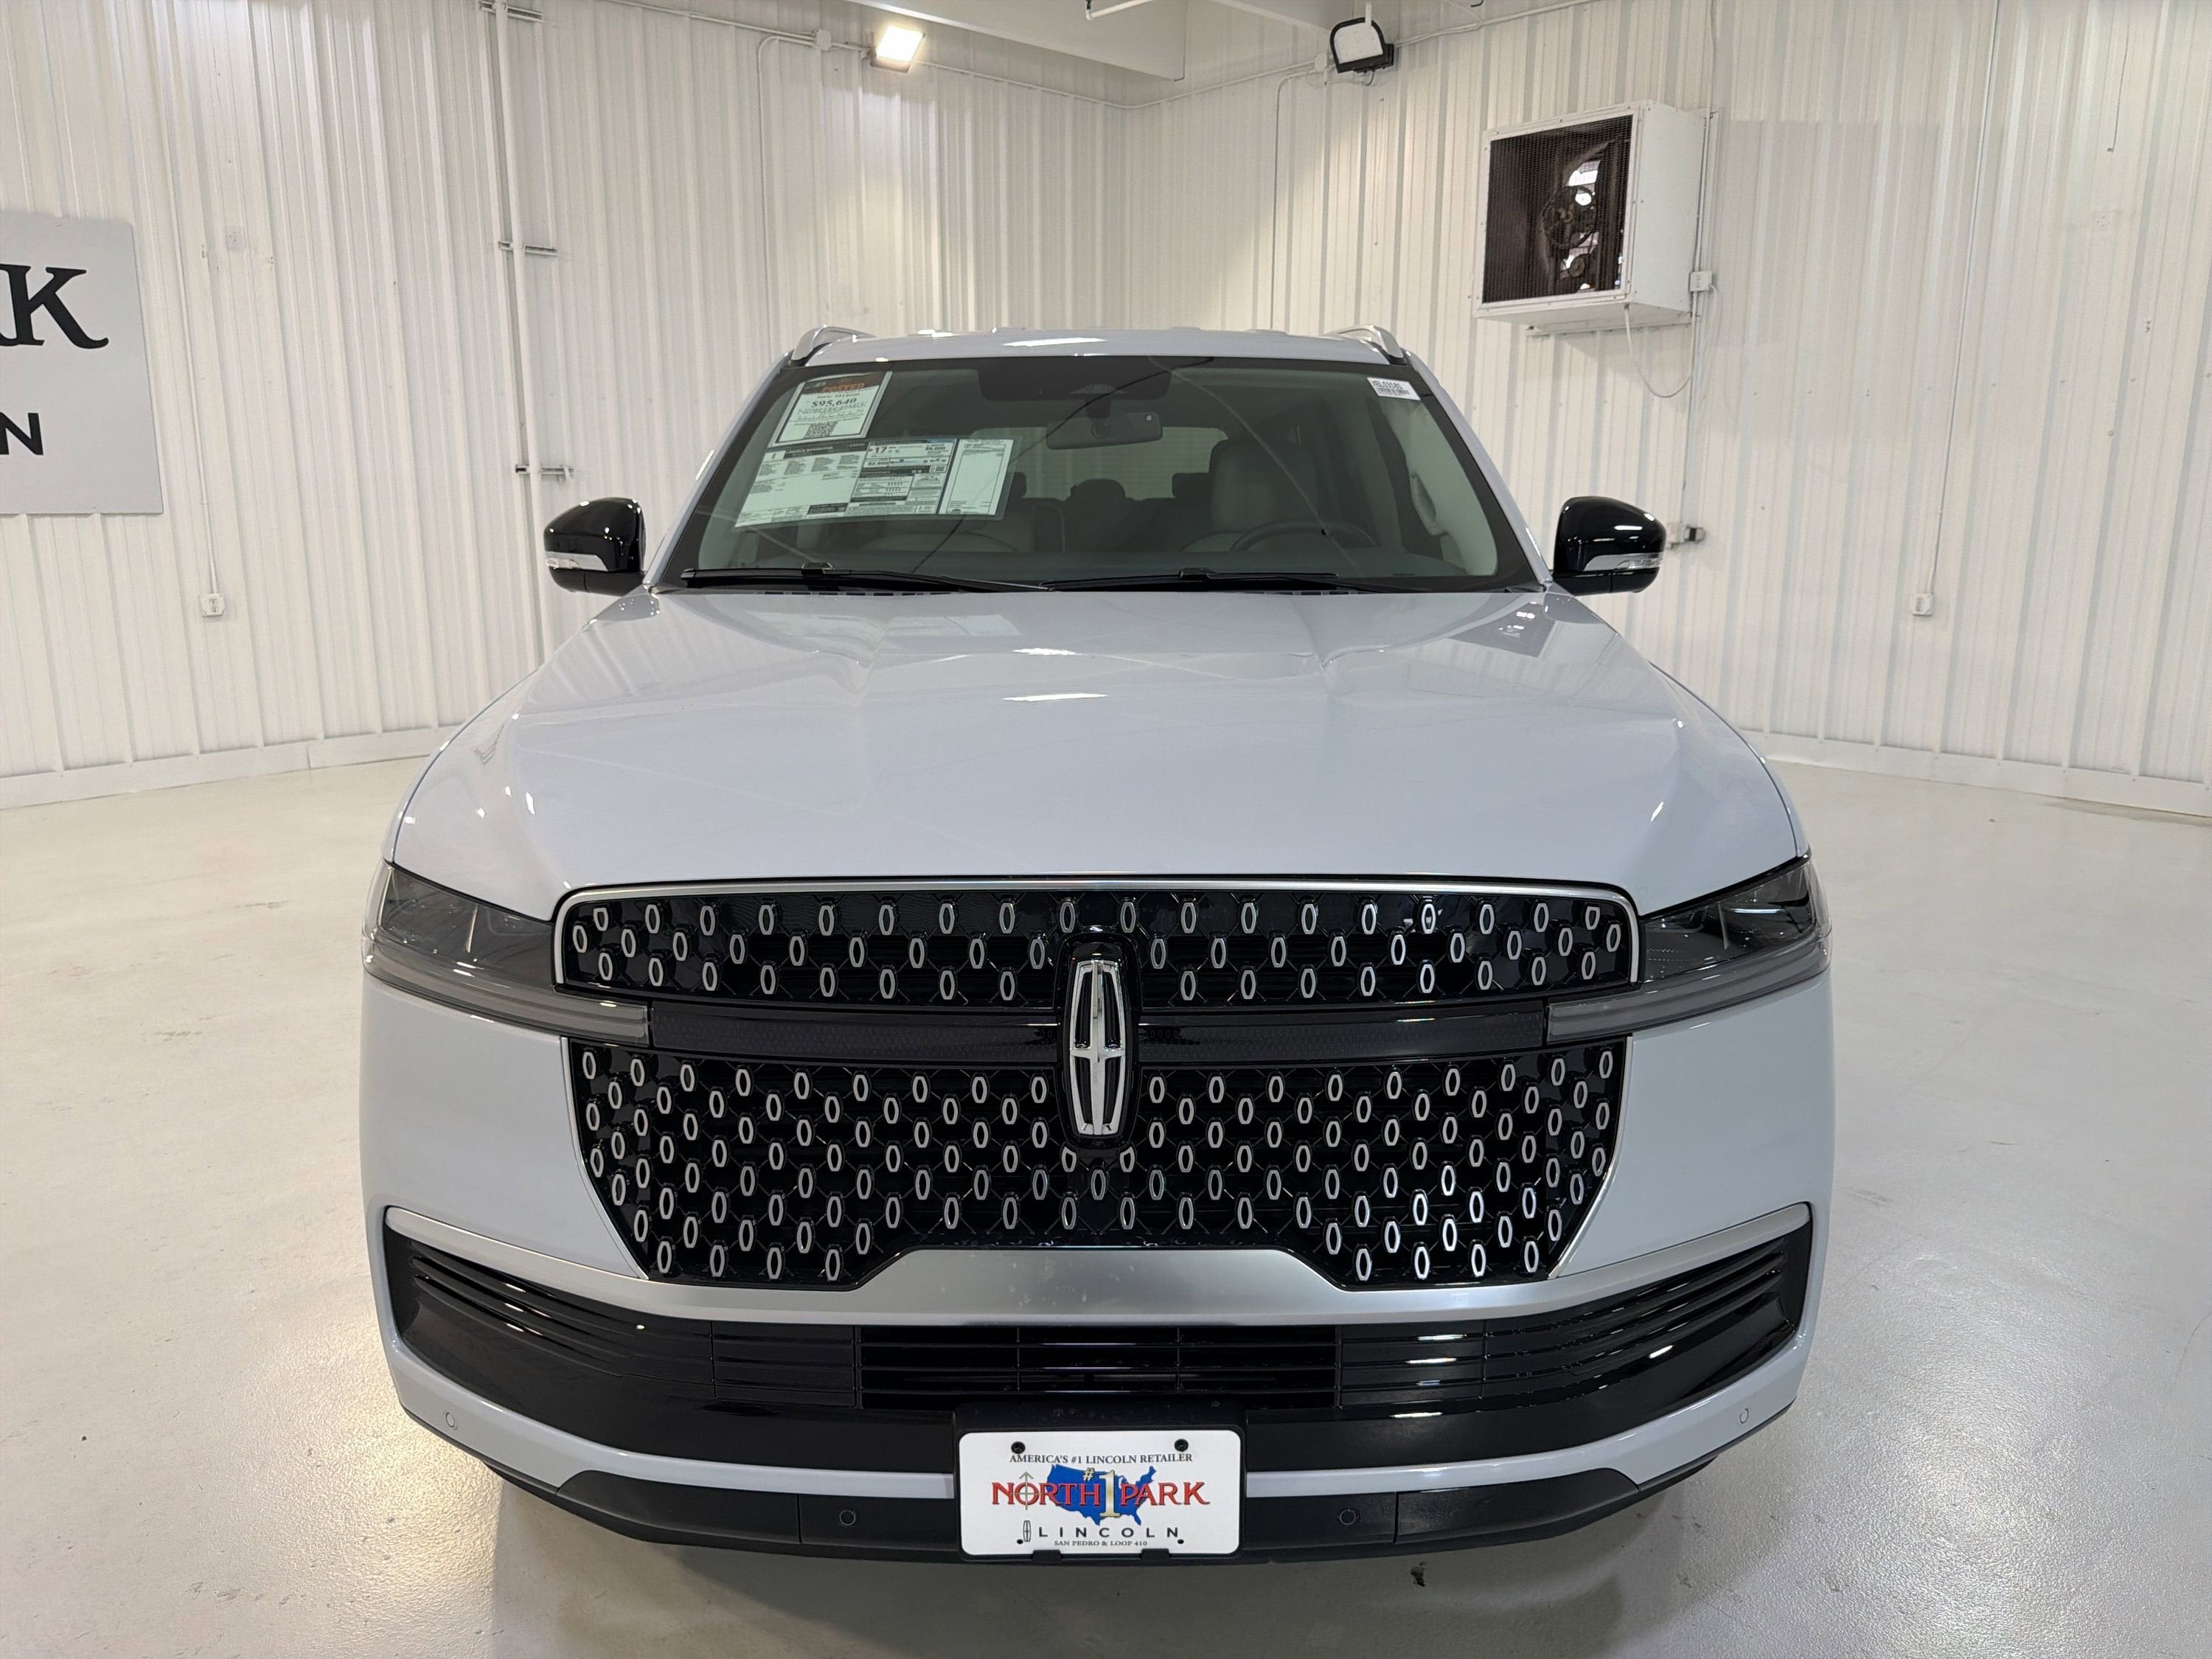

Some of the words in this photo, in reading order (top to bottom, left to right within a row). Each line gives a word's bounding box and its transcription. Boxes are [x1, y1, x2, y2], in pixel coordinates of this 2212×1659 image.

[811, 397, 858, 408] $95,640
[1009, 1454, 1068, 1464] AMERICA'S
[1071, 1455, 1082, 1464] #1
[1086, 1455, 1136, 1464] LINCOLN
[1140, 1453, 1193, 1463] RETAILER
[992, 1482, 1101, 1506] NORTH
[1120, 1481, 1211, 1506] PARK
[1038, 1526, 1179, 1538] LINCOLN
